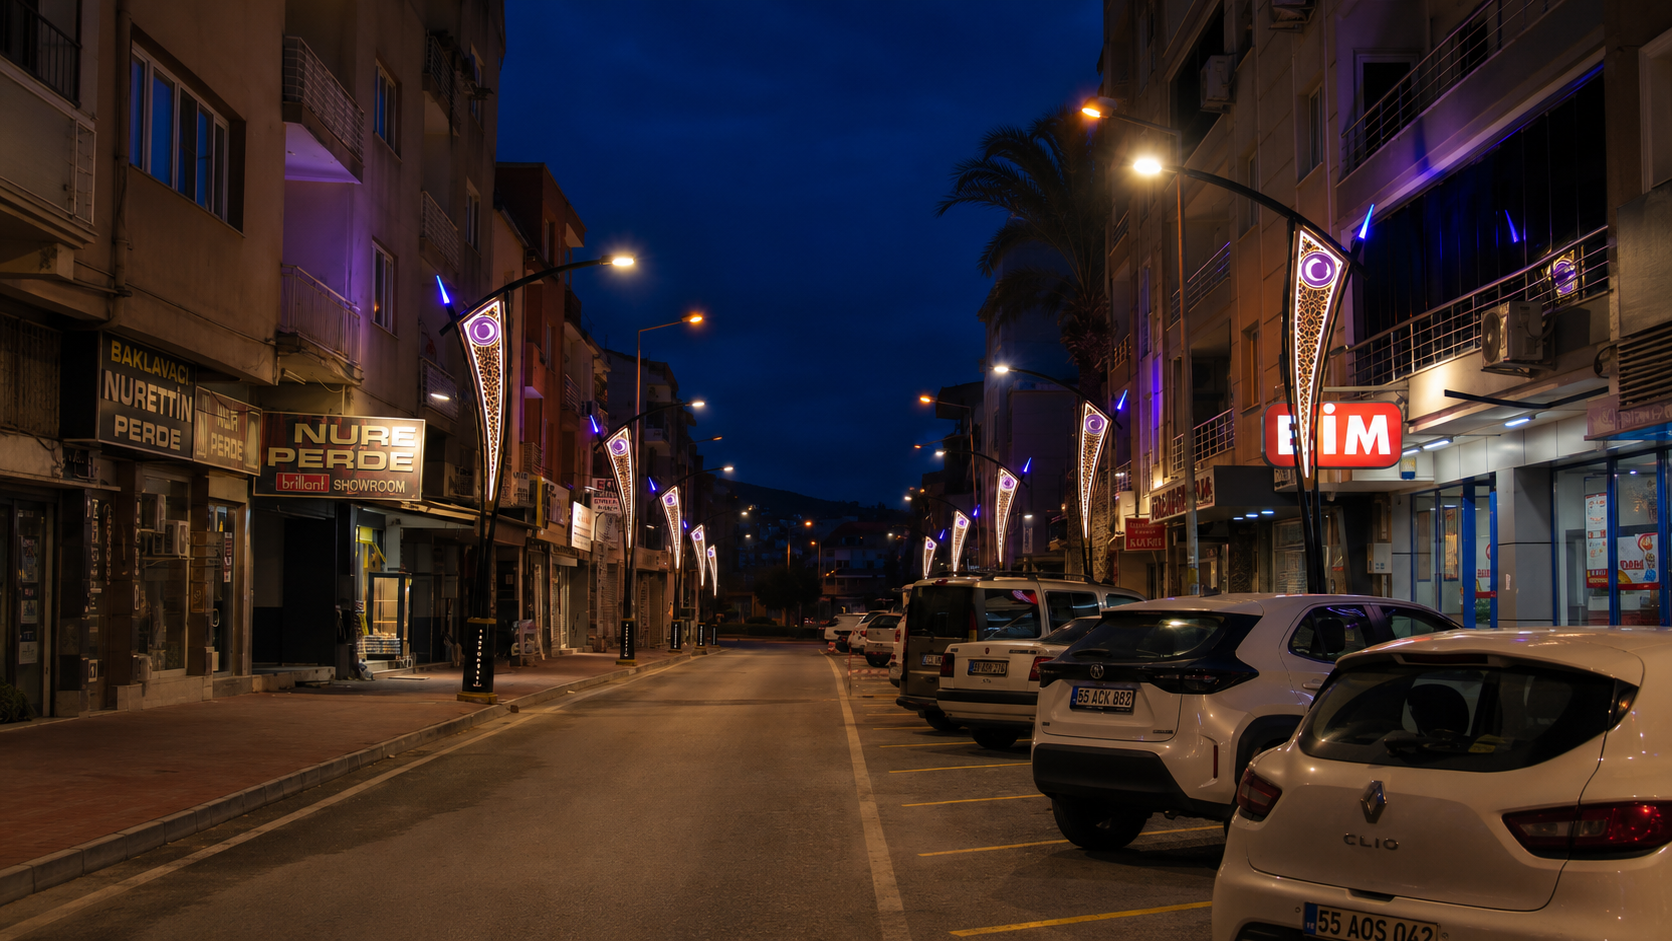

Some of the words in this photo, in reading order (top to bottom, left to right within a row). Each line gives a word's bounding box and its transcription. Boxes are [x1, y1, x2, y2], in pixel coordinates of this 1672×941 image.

[110, 339, 189, 386] BAKLAVACI
[104, 370, 192, 423] NURETTİN
[114, 414, 181, 451] PERDE
[294, 423, 417, 447] NURE
[267, 447, 415, 472] PERDE
[282, 474, 325, 491] brillant
[333, 478, 406, 494] SHOWROOM
[1078, 690, 1090, 703] 55
[1091, 690, 1110, 704] ACK
[1113, 691, 1132, 706] 882
[1343, 832, 1399, 851] CLIO
[1318, 910, 1341, 935] 55
[1347, 915, 1387, 941] AOS
[1394, 922, 1433, 941] 042
